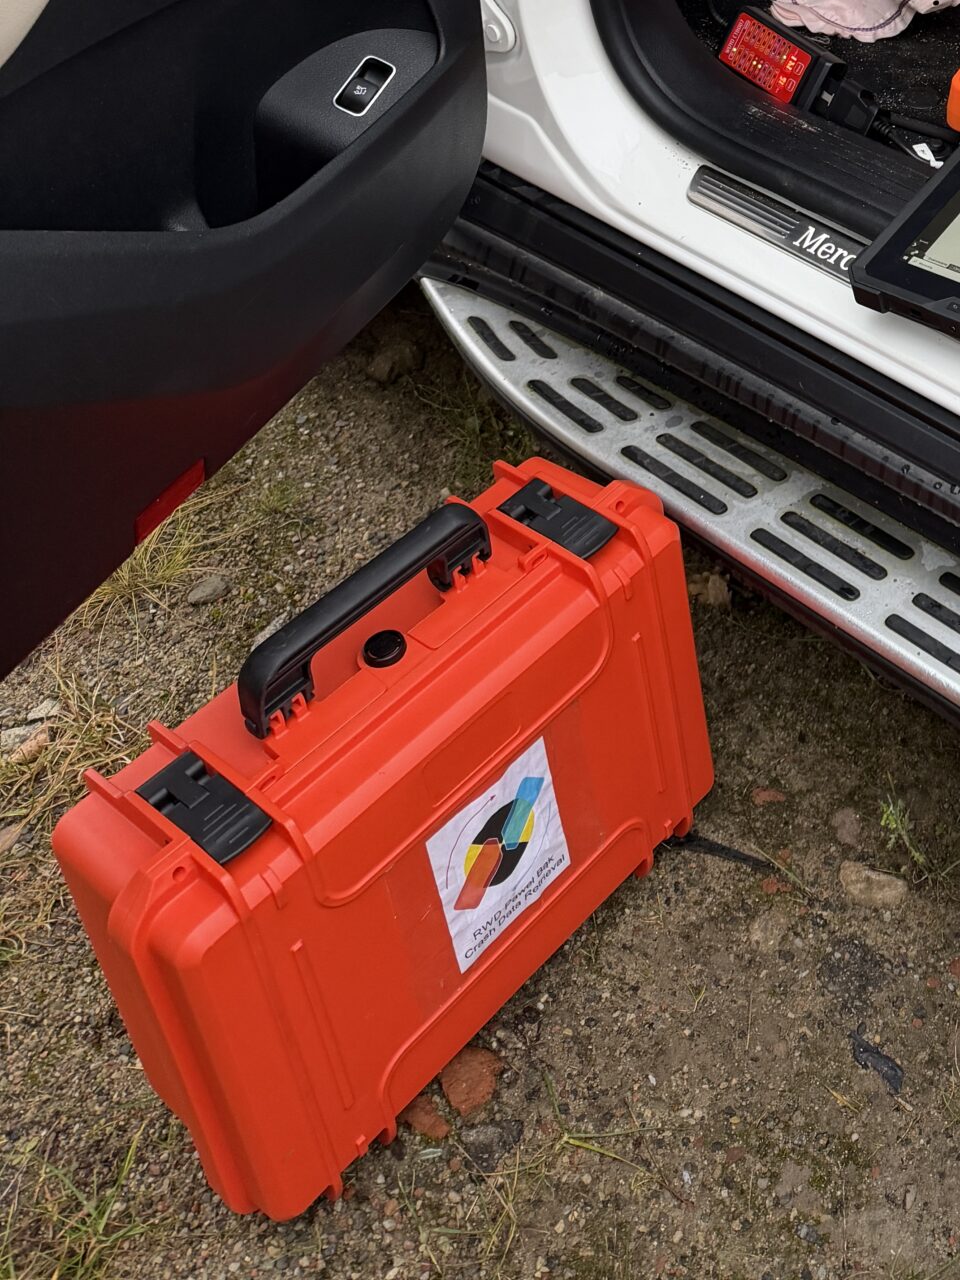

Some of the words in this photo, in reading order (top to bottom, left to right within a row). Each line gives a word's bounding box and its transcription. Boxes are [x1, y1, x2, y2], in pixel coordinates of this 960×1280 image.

[464, 926, 496, 960] Crash
[498, 901, 522, 926] Data
[524, 854, 565, 900] Retrieval
[473, 910, 502, 940] RWD
